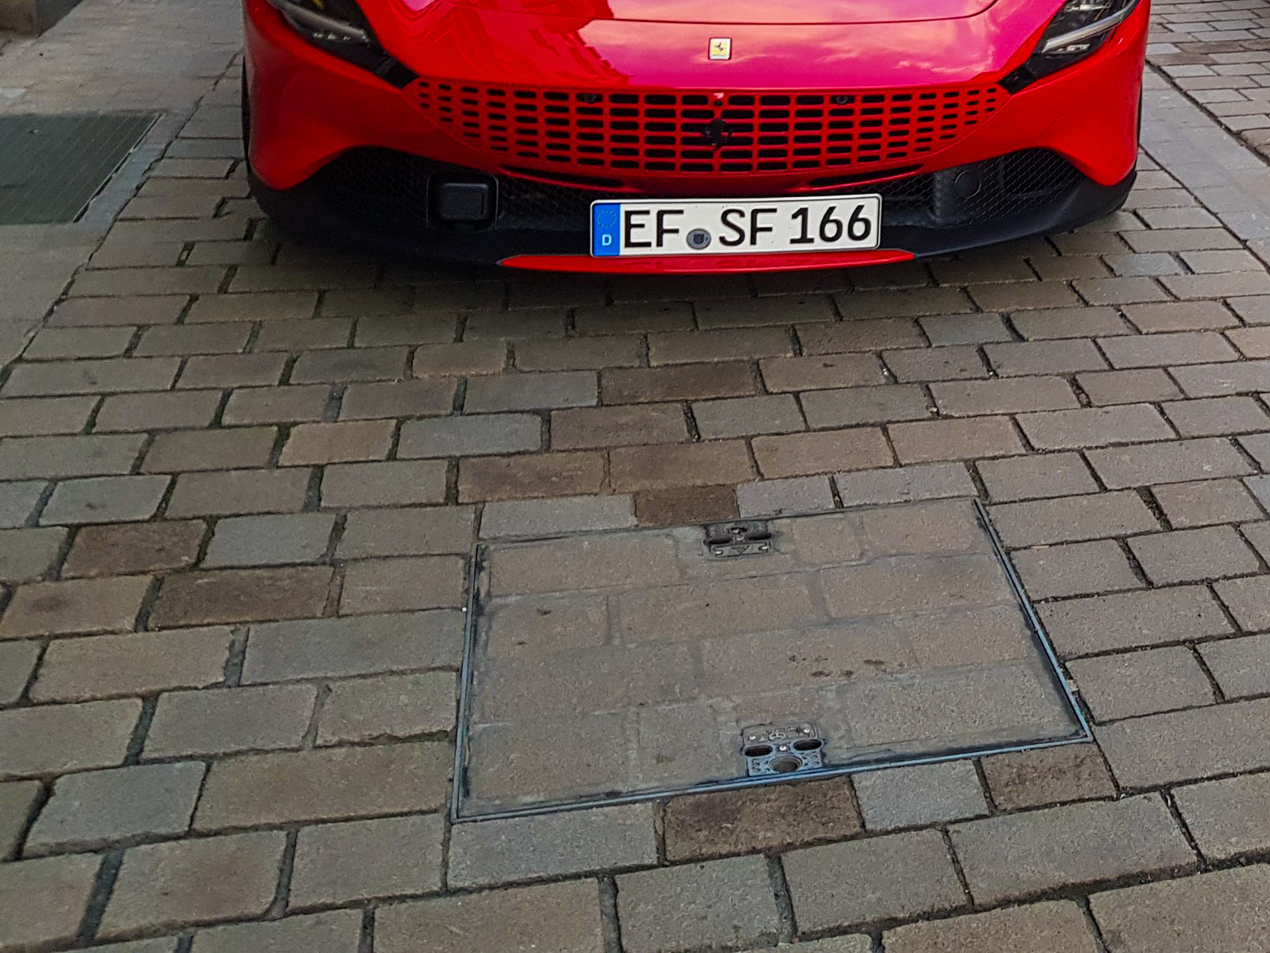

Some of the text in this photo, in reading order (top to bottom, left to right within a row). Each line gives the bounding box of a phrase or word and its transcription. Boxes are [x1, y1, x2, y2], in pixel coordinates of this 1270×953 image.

[601, 204, 872, 248] D EF SF 166
